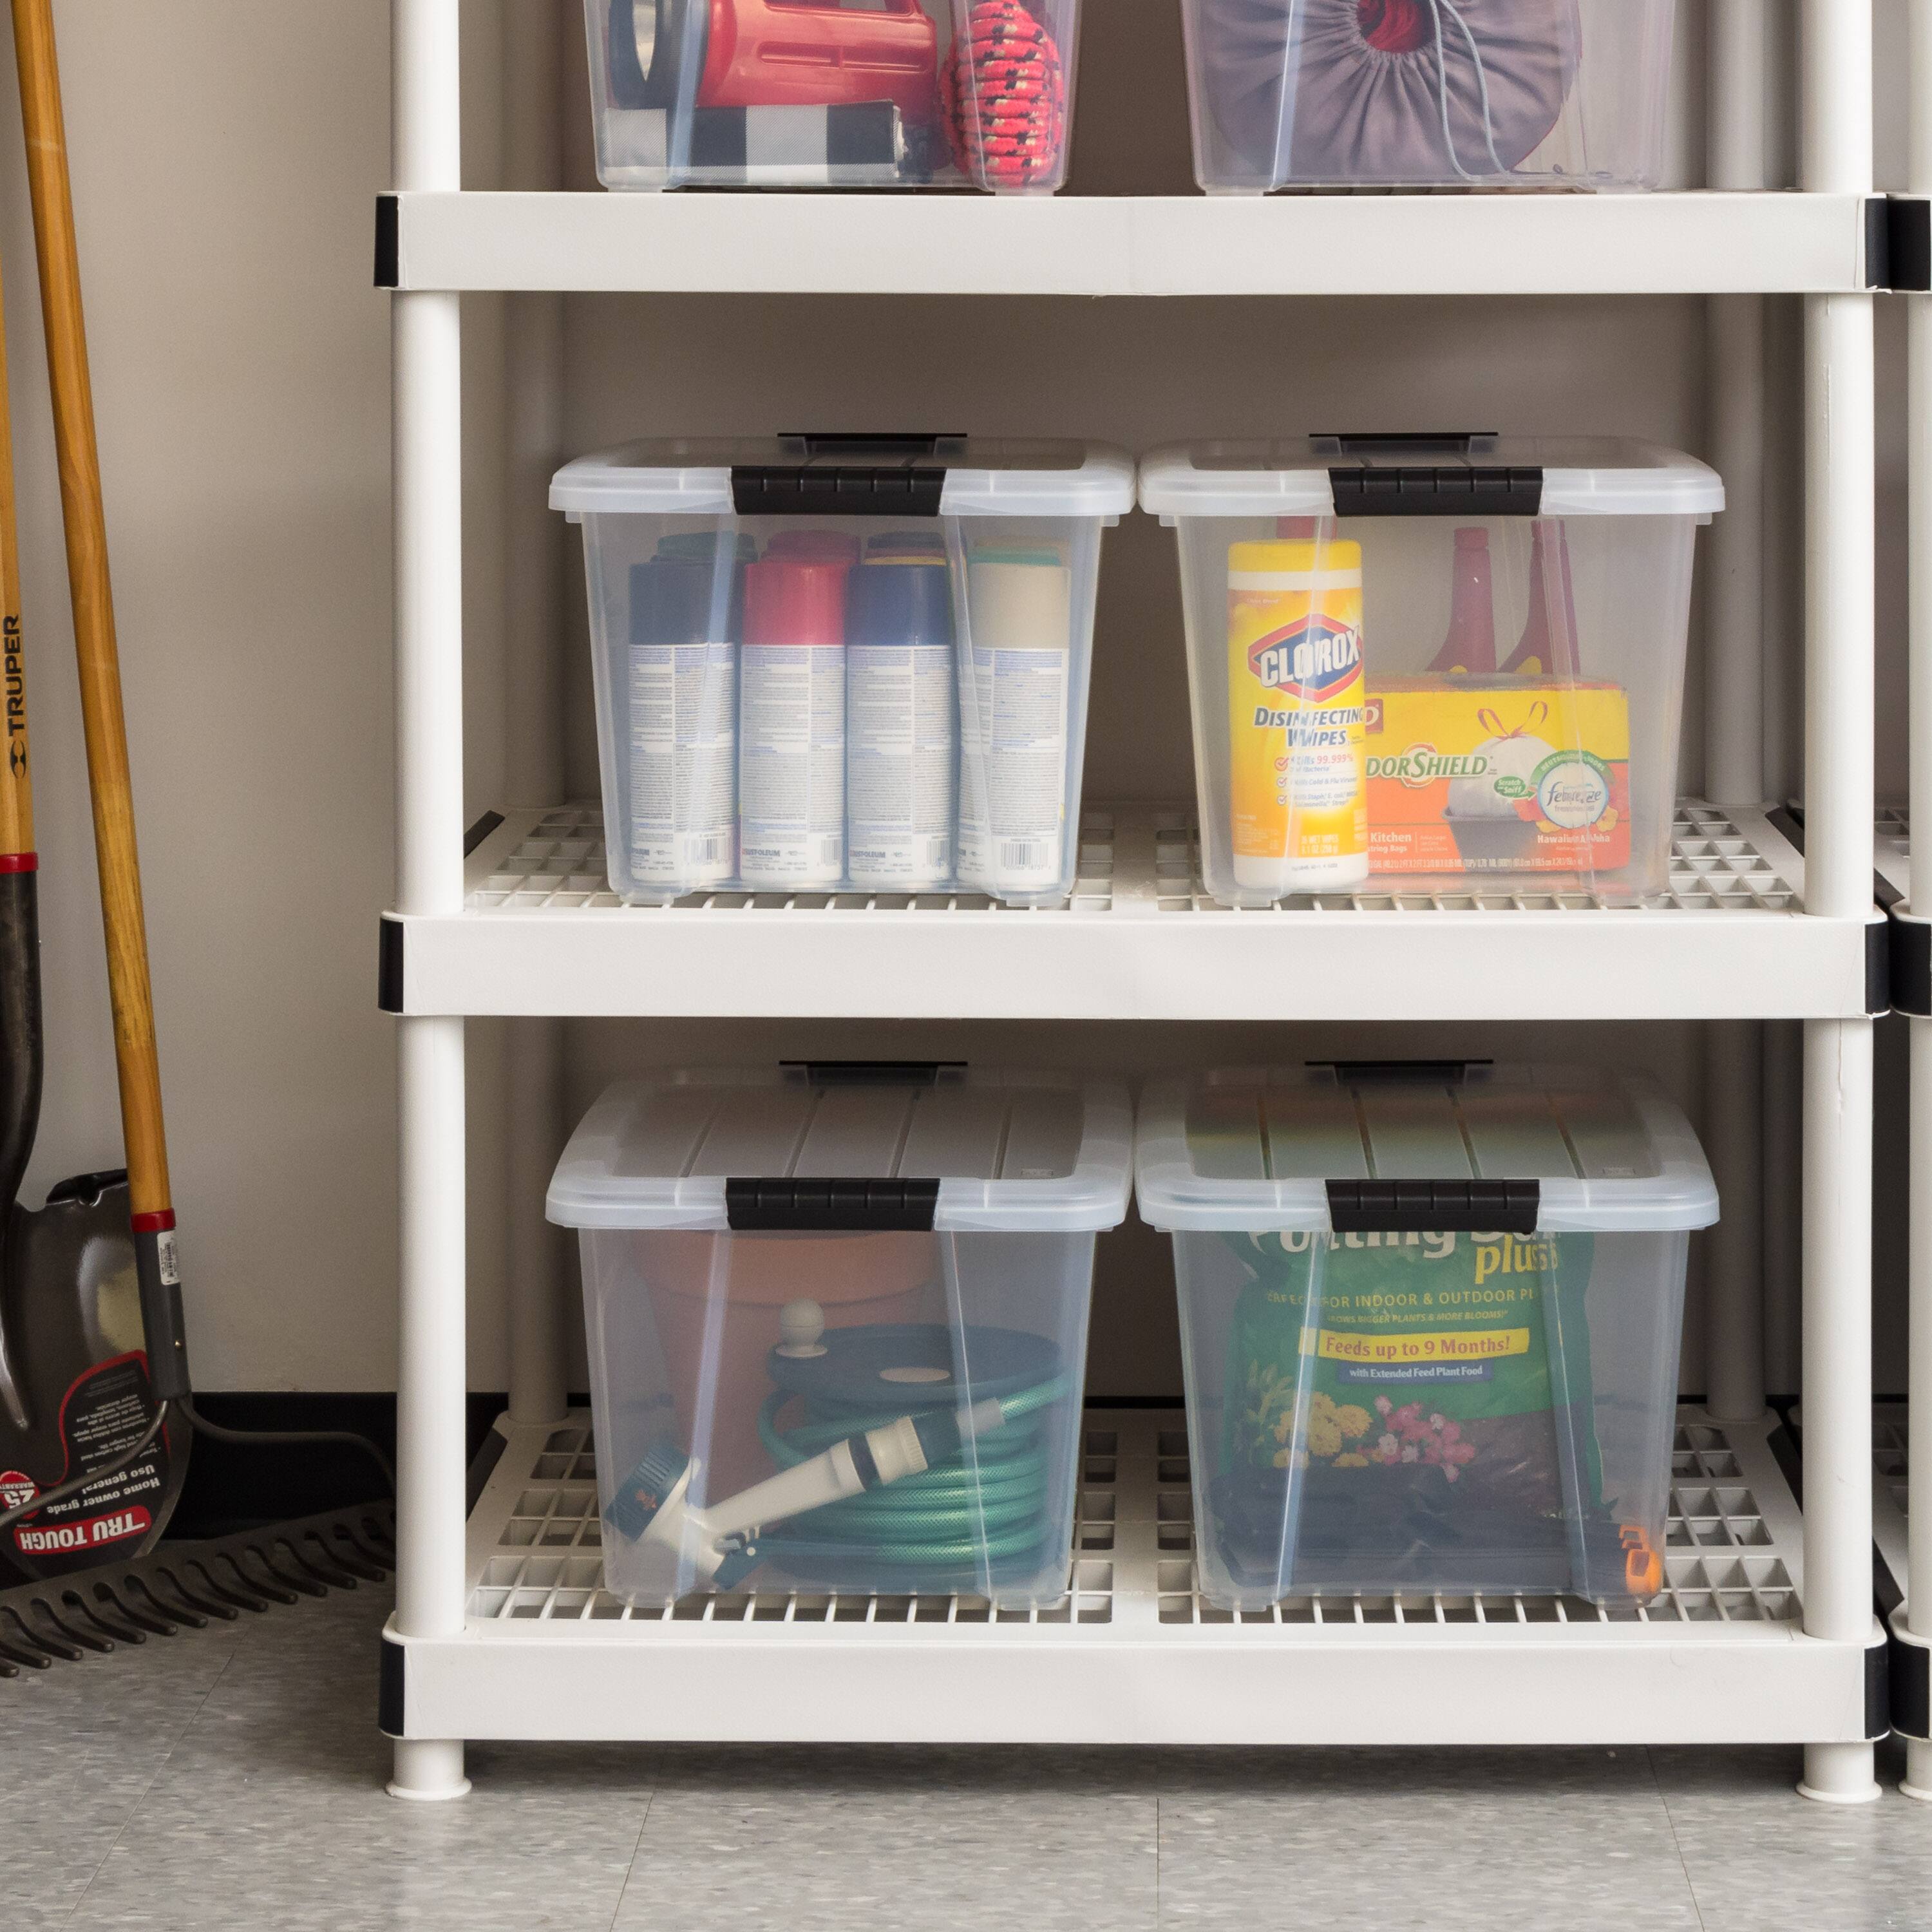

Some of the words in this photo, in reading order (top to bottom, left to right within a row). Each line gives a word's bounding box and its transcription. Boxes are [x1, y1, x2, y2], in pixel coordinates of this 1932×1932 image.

[1260, 624, 1359, 687] CLOROX
[3, 615, 25, 737] TRUPER
[1366, 752, 1488, 778] DORSHIELD
[1370, 831, 1412, 842] Kitchen
[1390, 844, 1408, 853] Bags
[1356, 1293, 1417, 1307] INDOOR
[1423, 1293, 1434, 1305] &
[1439, 1289, 1515, 1304] OUTDOOR
[1392, 1312, 1426, 1323] PLANTS
[1437, 1312, 1463, 1321] MORE
[1325, 1336, 1370, 1357] Feeds
[1376, 1346, 1397, 1360] up
[1402, 1343, 1419, 1356] to
[1424, 1340, 1435, 1354] 9
[1441, 1336, 1510, 1354] Months!
[1350, 1368, 1369, 1378] with
[1370, 1368, 1412, 1378] Extended
[1414, 1368, 1435, 1377] Feed
[1436, 1367, 1461, 1377] Plant
[1461, 1365, 1483, 1376] Food
[131, 1464, 156, 1477] Uso
[124, 1477, 161, 1495] Home
[3, 1488, 35, 1510] 25
[46, 1499, 80, 1515] grade
[82, 1490, 120, 1507] owner
[92, 1512, 146, 1542] TRU
[19, 1526, 88, 1549] TOUGH
